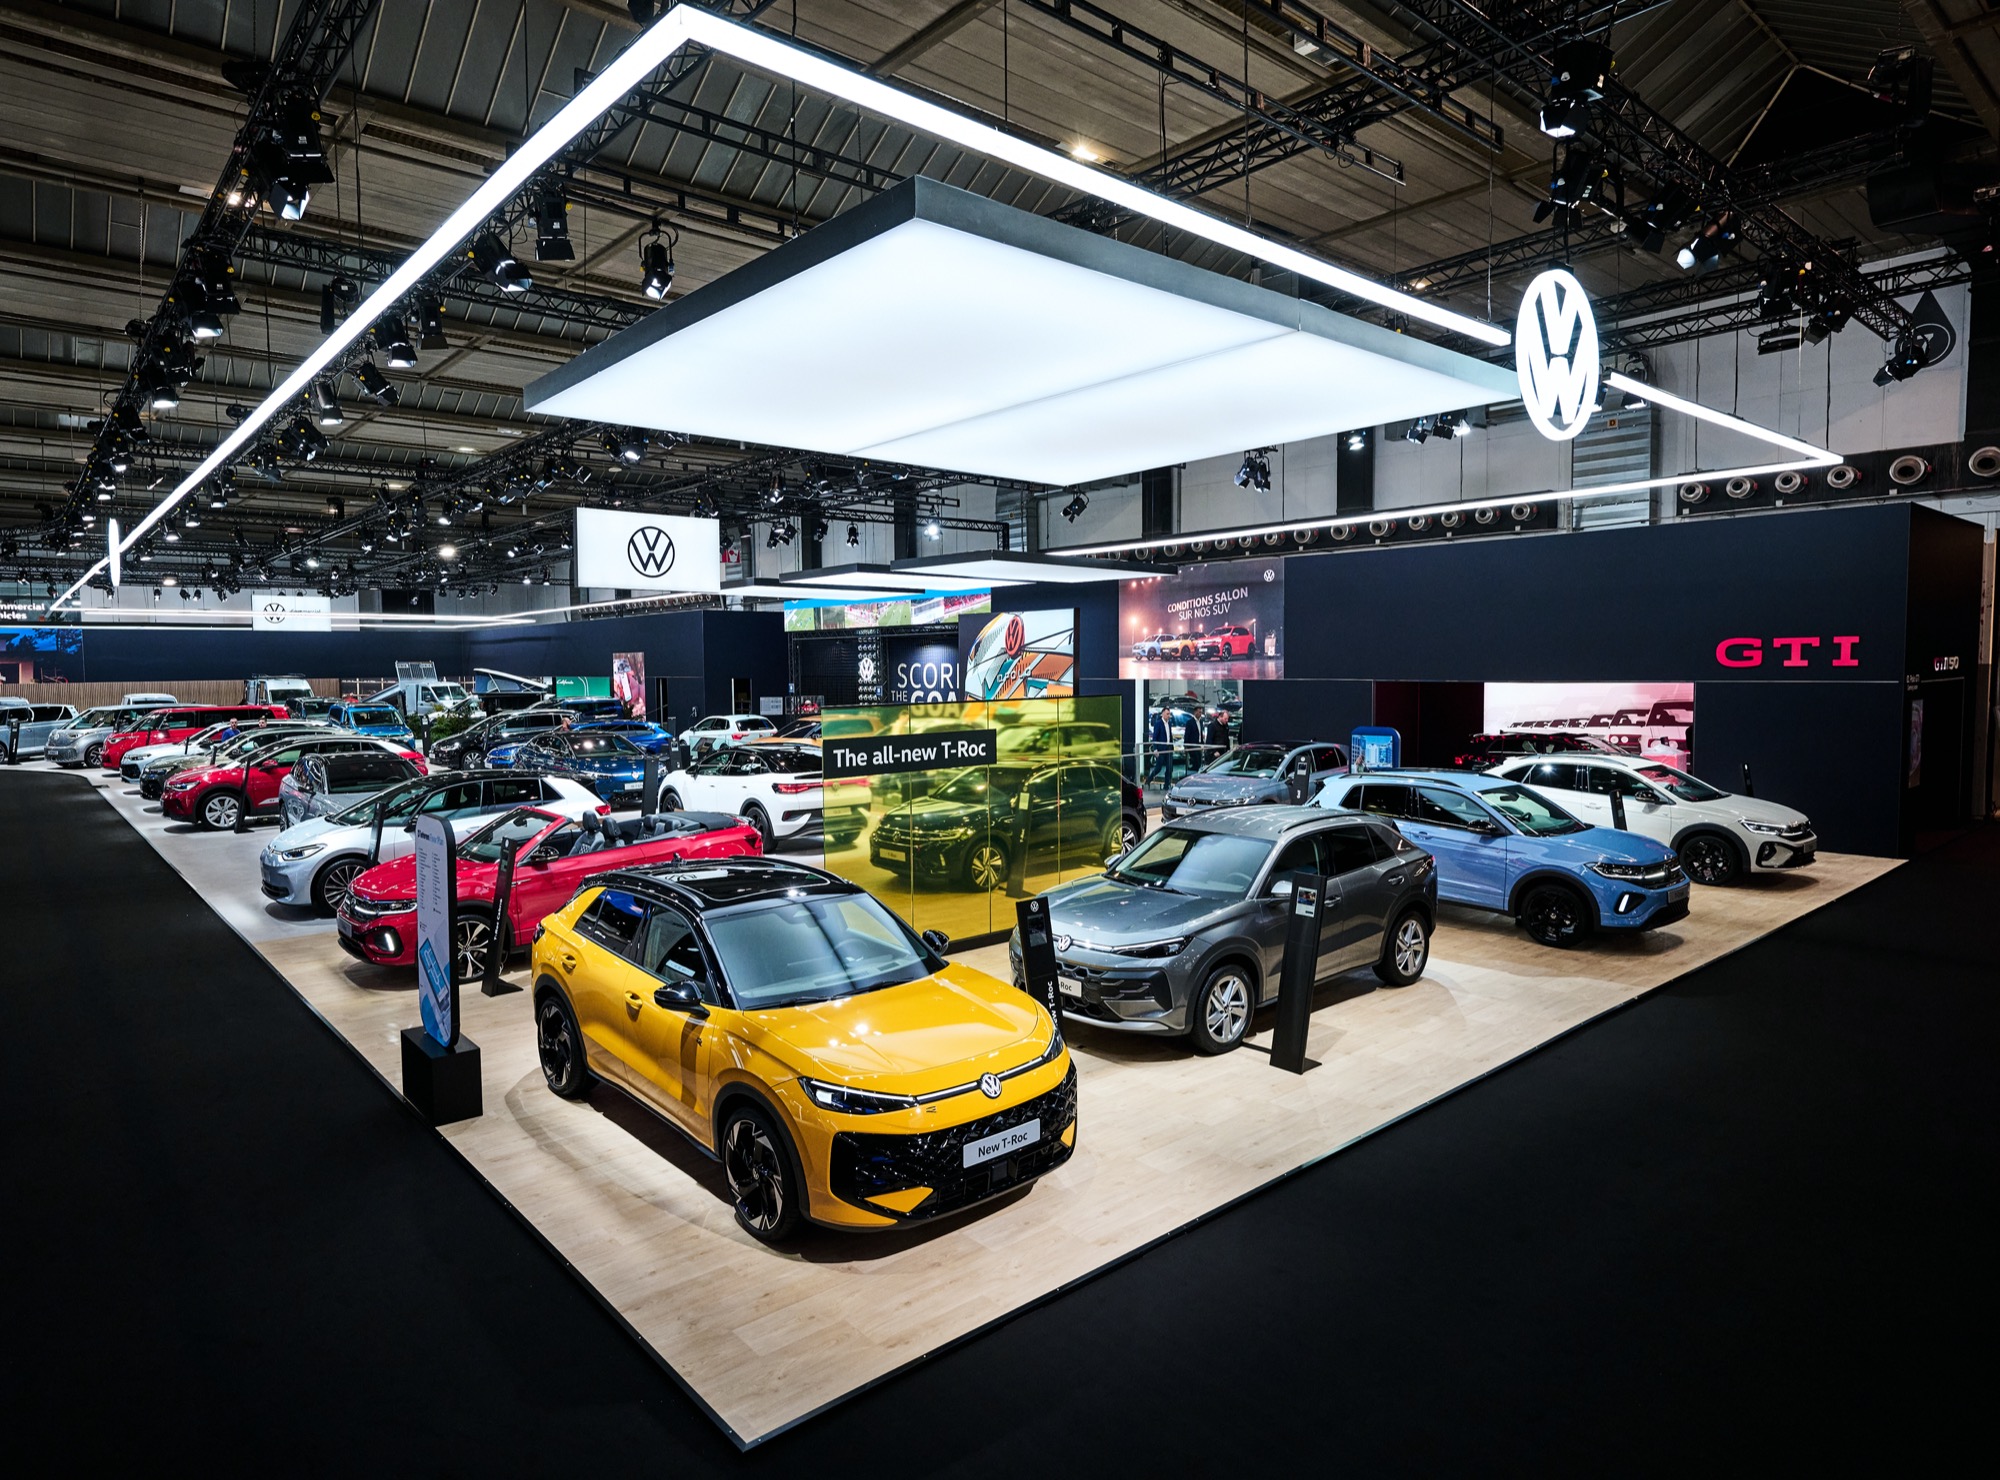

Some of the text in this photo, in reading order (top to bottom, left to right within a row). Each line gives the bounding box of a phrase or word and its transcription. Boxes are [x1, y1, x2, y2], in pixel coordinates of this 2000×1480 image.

[1515, 269, 1600, 442] VW
[627, 526, 676, 579] VW
[1167, 586, 1248, 613] CONDITIONS SALON
[1178, 602, 1231, 621] SUR NOS SUV
[1715, 635, 1860, 668] GTI
[897, 662, 960, 690] SCORI
[891, 690, 907, 702] THE
[833, 740, 986, 768] The all-new T-Roc
[1047, 981, 1056, 1009] T-Roc
[978, 1132, 1028, 1158] New T-Roc
